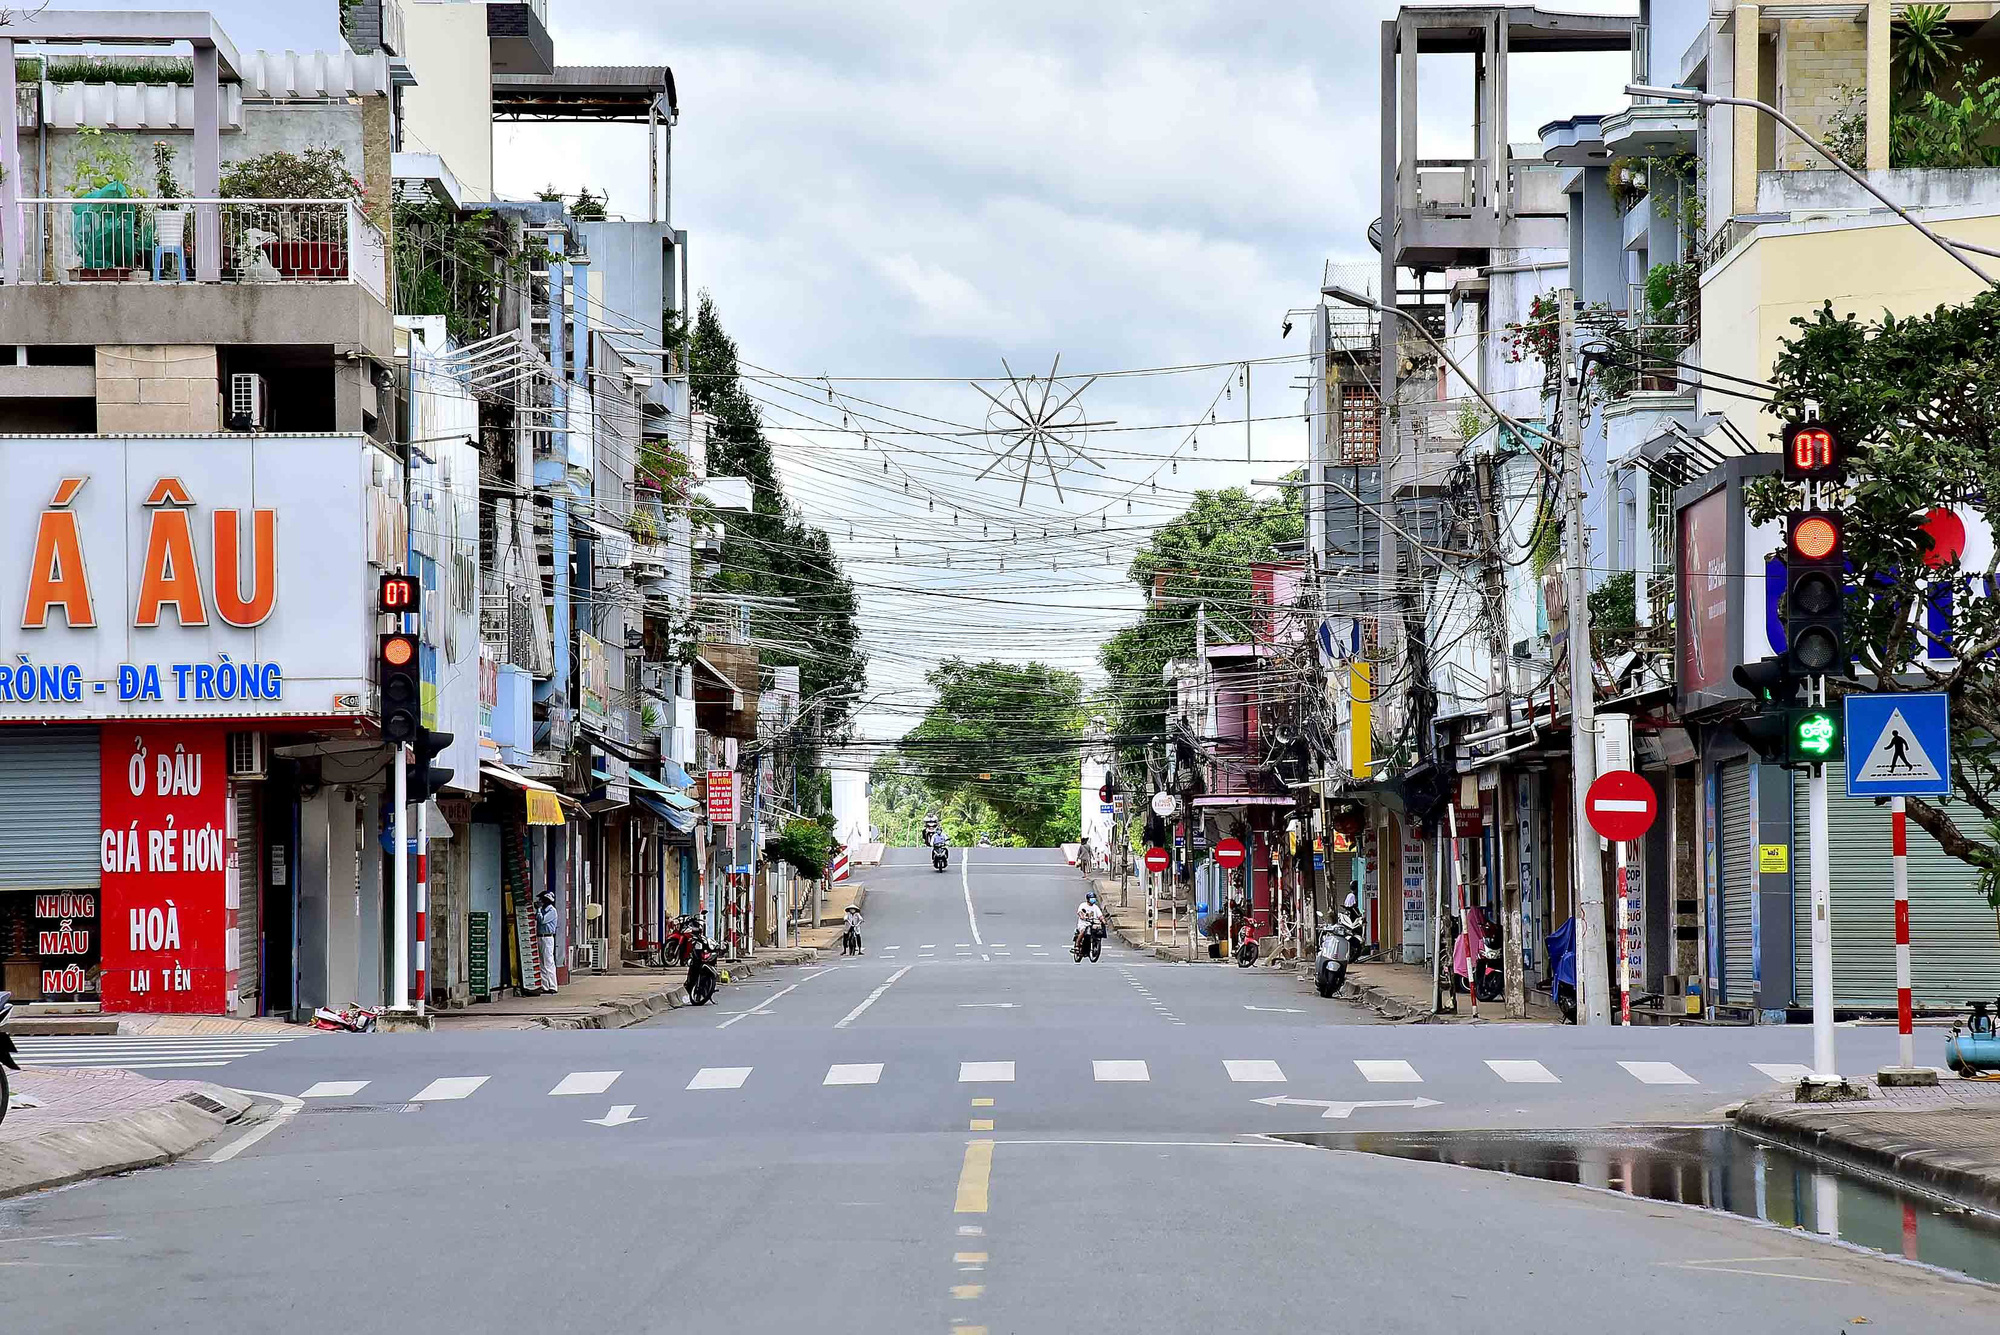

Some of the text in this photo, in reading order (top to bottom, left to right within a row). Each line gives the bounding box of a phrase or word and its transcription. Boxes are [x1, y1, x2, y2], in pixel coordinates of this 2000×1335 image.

[1796, 433, 1830, 467] 07
[21, 476, 279, 629] Á ÂU
[386, 581, 409, 605] 07
[117, 664, 163, 701] ĐA
[171, 652, 284, 701] TRÒNG
[128, 735, 202, 797] Ở ĐÂU
[101, 813, 223, 873] GIÁ RẺ HƠN
[35, 889, 95, 918] NHỮNG
[39, 920, 89, 955] MẪU
[130, 899, 181, 951] HOÀ
[43, 964, 85, 994] MỚI
[130, 969, 150, 996] LẠI
